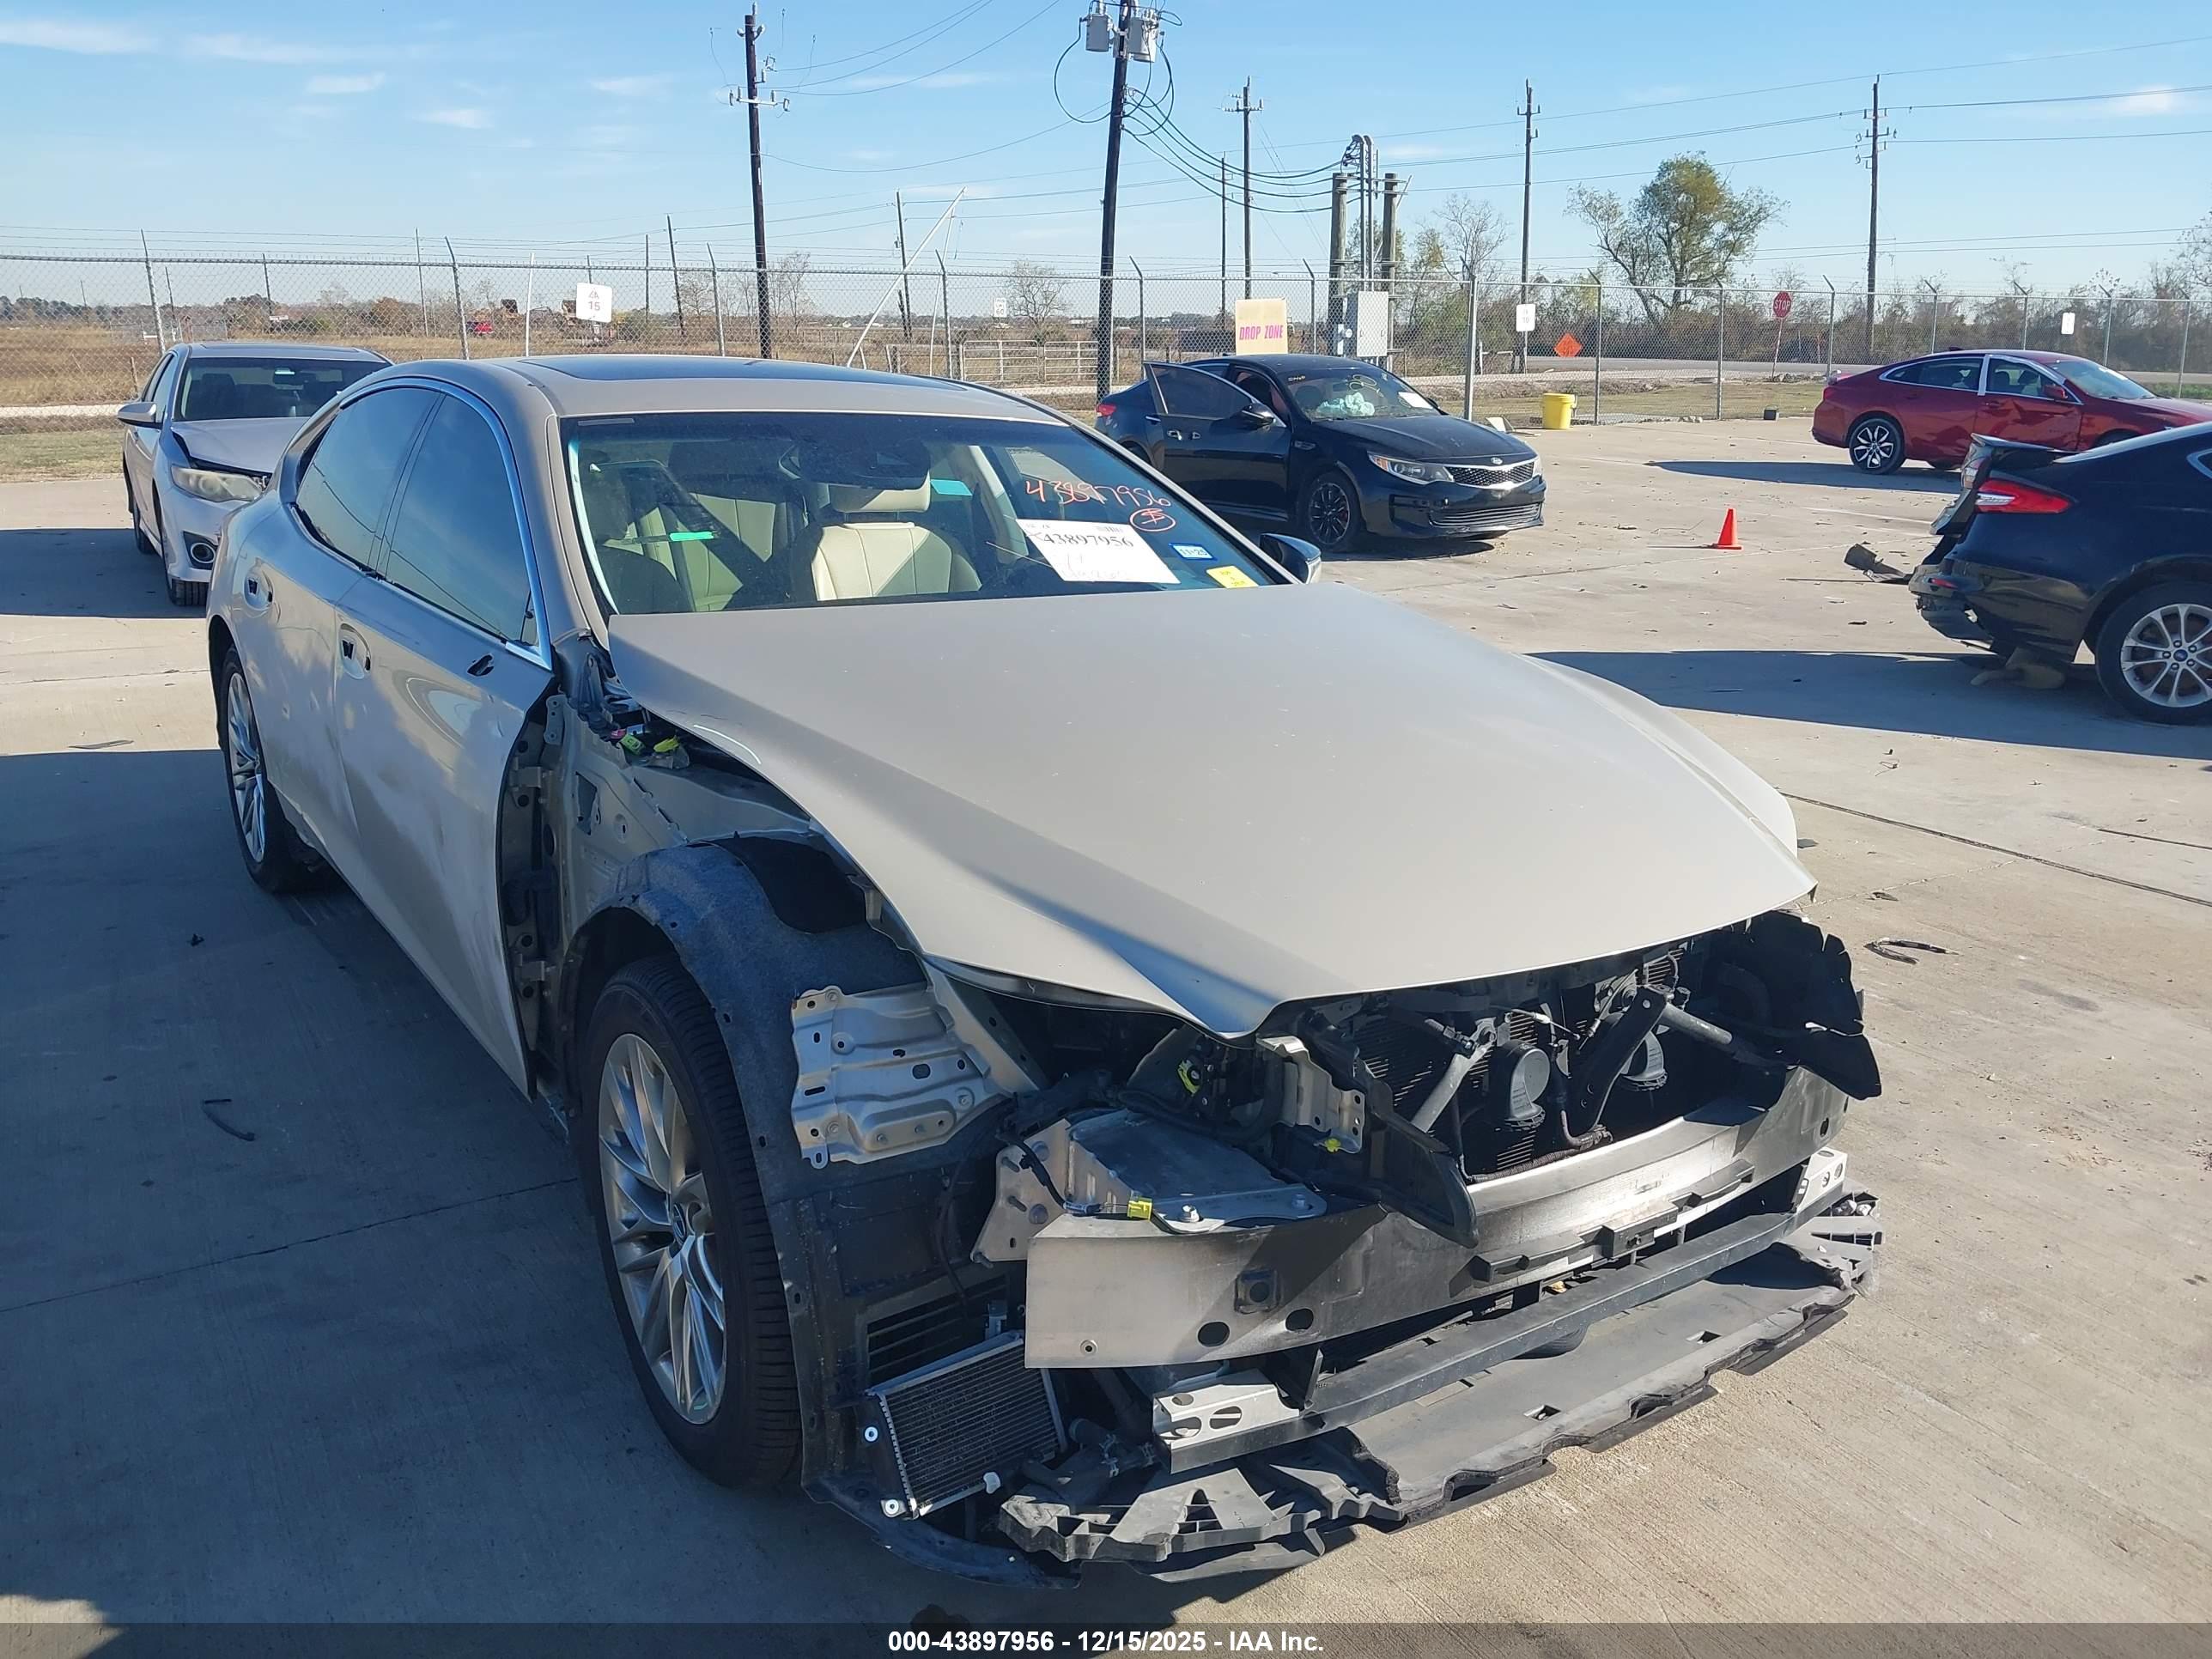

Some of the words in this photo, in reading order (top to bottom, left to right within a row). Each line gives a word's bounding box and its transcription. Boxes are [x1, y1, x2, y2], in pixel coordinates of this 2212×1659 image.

[587, 301, 601, 312] 15
[1774, 300, 1791, 311] STOP
[1238, 325, 1261, 341] DROP
[1264, 325, 1284, 340] ZONE
[1025, 480, 1172, 507] 43897956
[1043, 533, 1134, 548] 43897956
